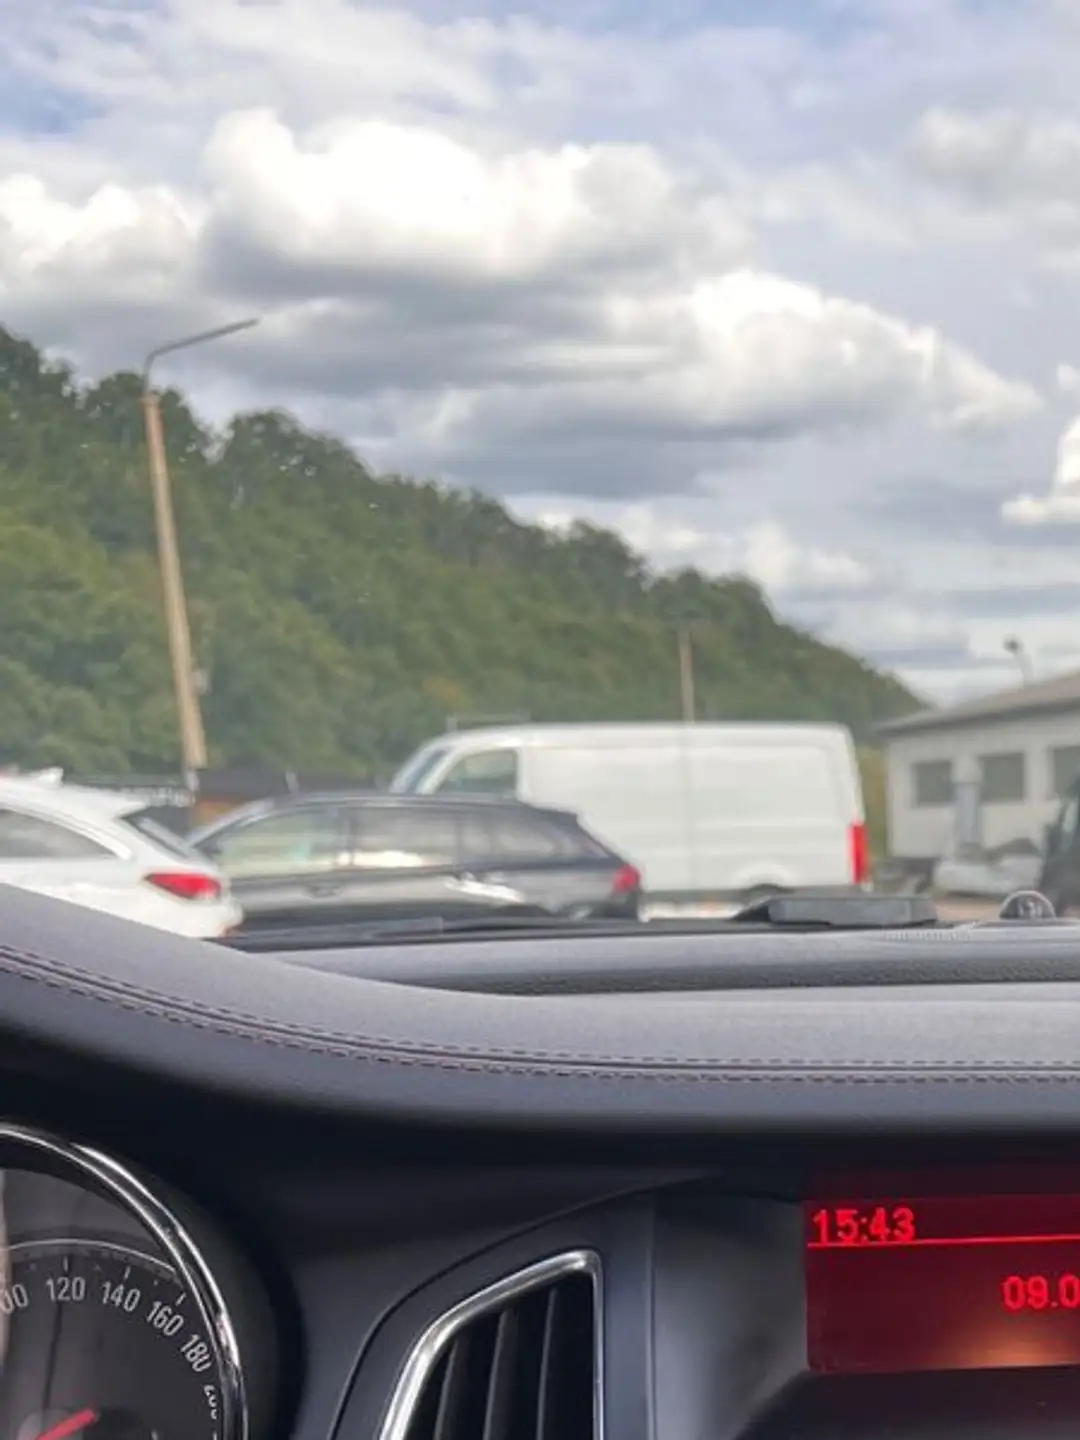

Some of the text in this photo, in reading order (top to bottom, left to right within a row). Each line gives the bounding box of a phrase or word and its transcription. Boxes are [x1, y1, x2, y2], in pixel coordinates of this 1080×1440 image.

[812, 1207, 915, 1244] 15:43
[0, 1284, 28, 1315] 00
[45, 1276, 86, 1301] 120
[101, 1281, 141, 1312] 140
[146, 1301, 184, 1336] 160
[180, 1334, 212, 1372] 180
